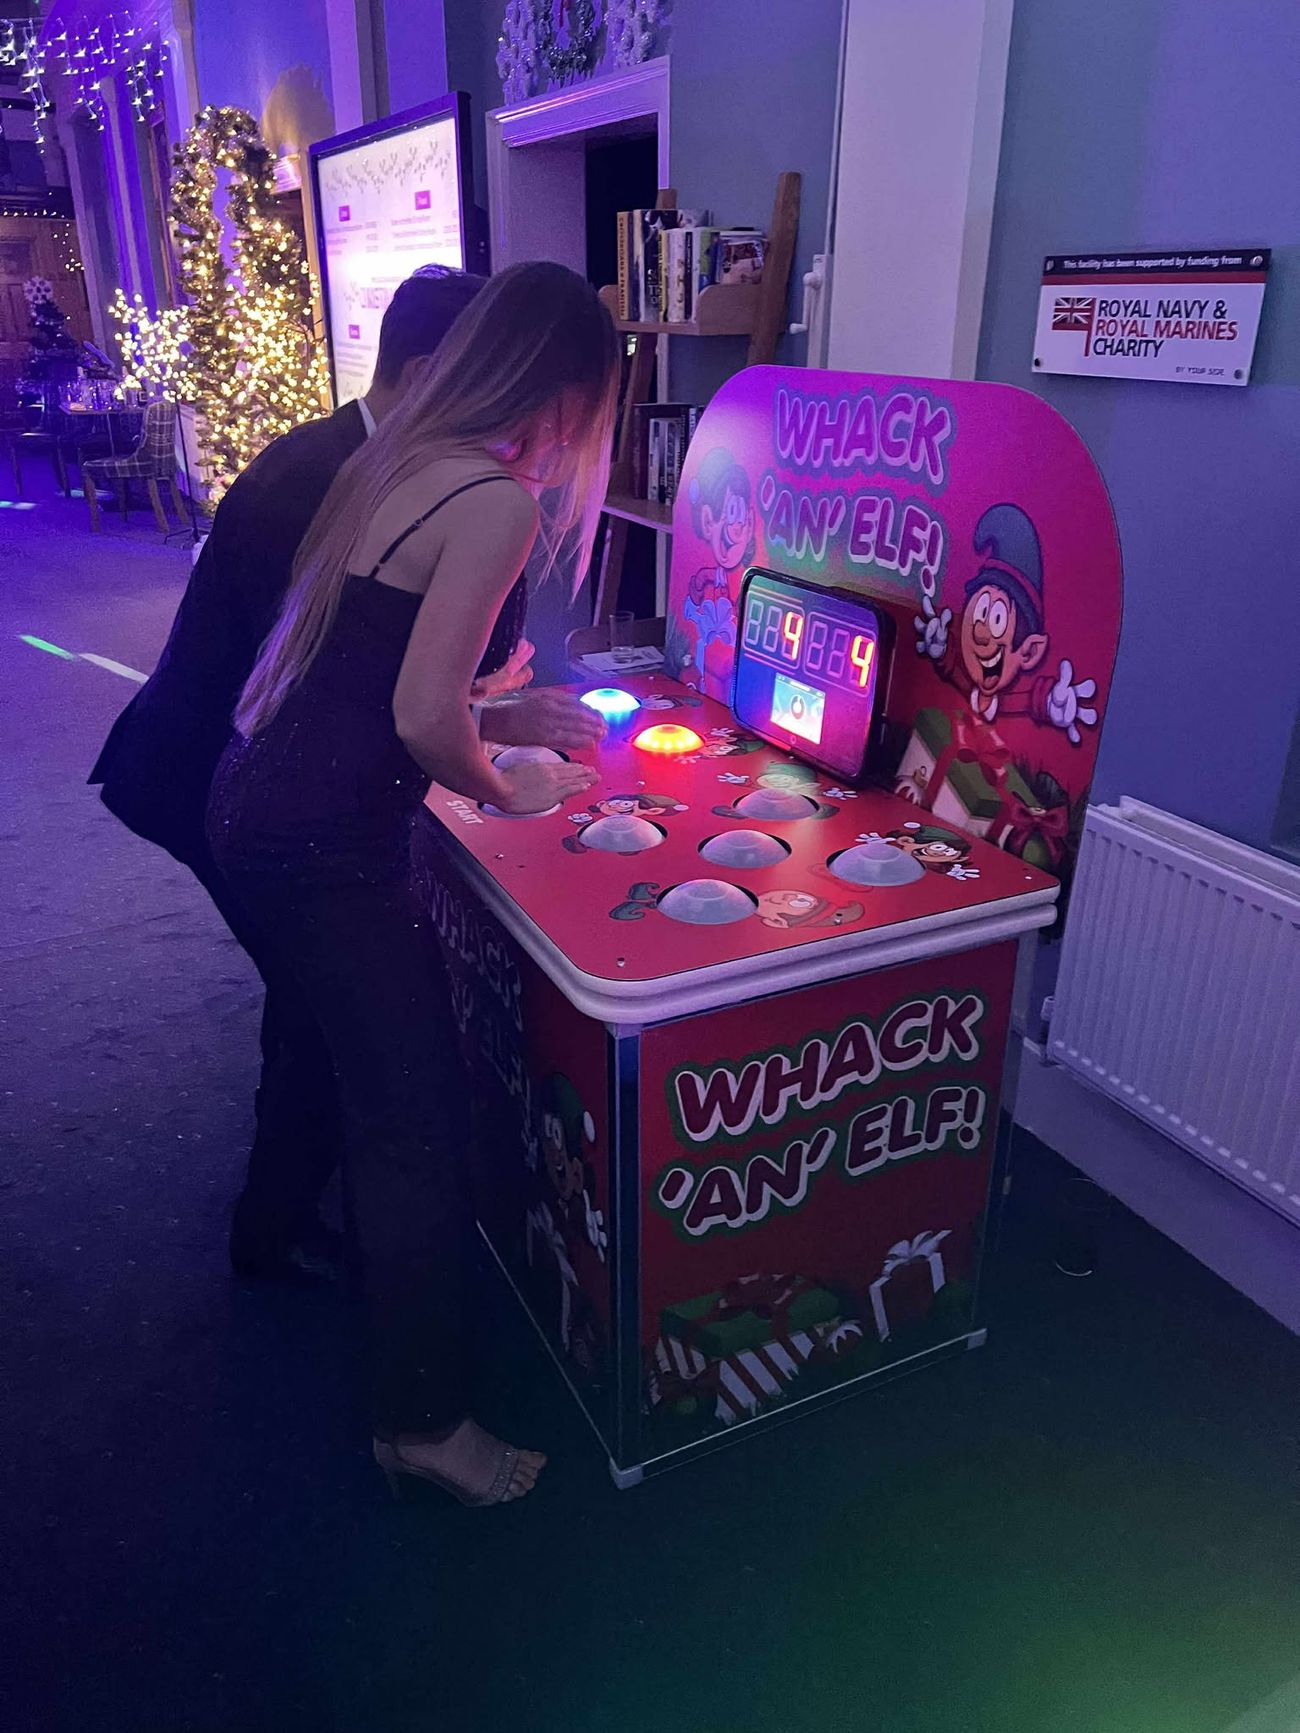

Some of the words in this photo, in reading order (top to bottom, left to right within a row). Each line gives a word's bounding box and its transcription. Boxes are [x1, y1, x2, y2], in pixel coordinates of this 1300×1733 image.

[1077, 259, 1101, 271] facility
[1102, 259, 1116, 268] has
[1116, 258, 1135, 268] been
[1135, 257, 1175, 269] supported
[1175, 256, 1187, 269] by
[1187, 256, 1220, 267] funding
[1220, 255, 1243, 265] from
[1097, 299, 1152, 319] ROYAL
[1156, 299, 1210, 319] NAVY
[1212, 299, 1228, 320] &
[1094, 319, 1149, 339] ROYAL
[1152, 320, 1239, 341] MARINES
[1092, 338, 1165, 358] CHARITY
[777, 389, 952, 486] WHACK
[848, 496, 943, 597] ELF!
[445, 799, 485, 824] START
[675, 994, 984, 1143] WHACK
[844, 1086, 986, 1177] ELF!
